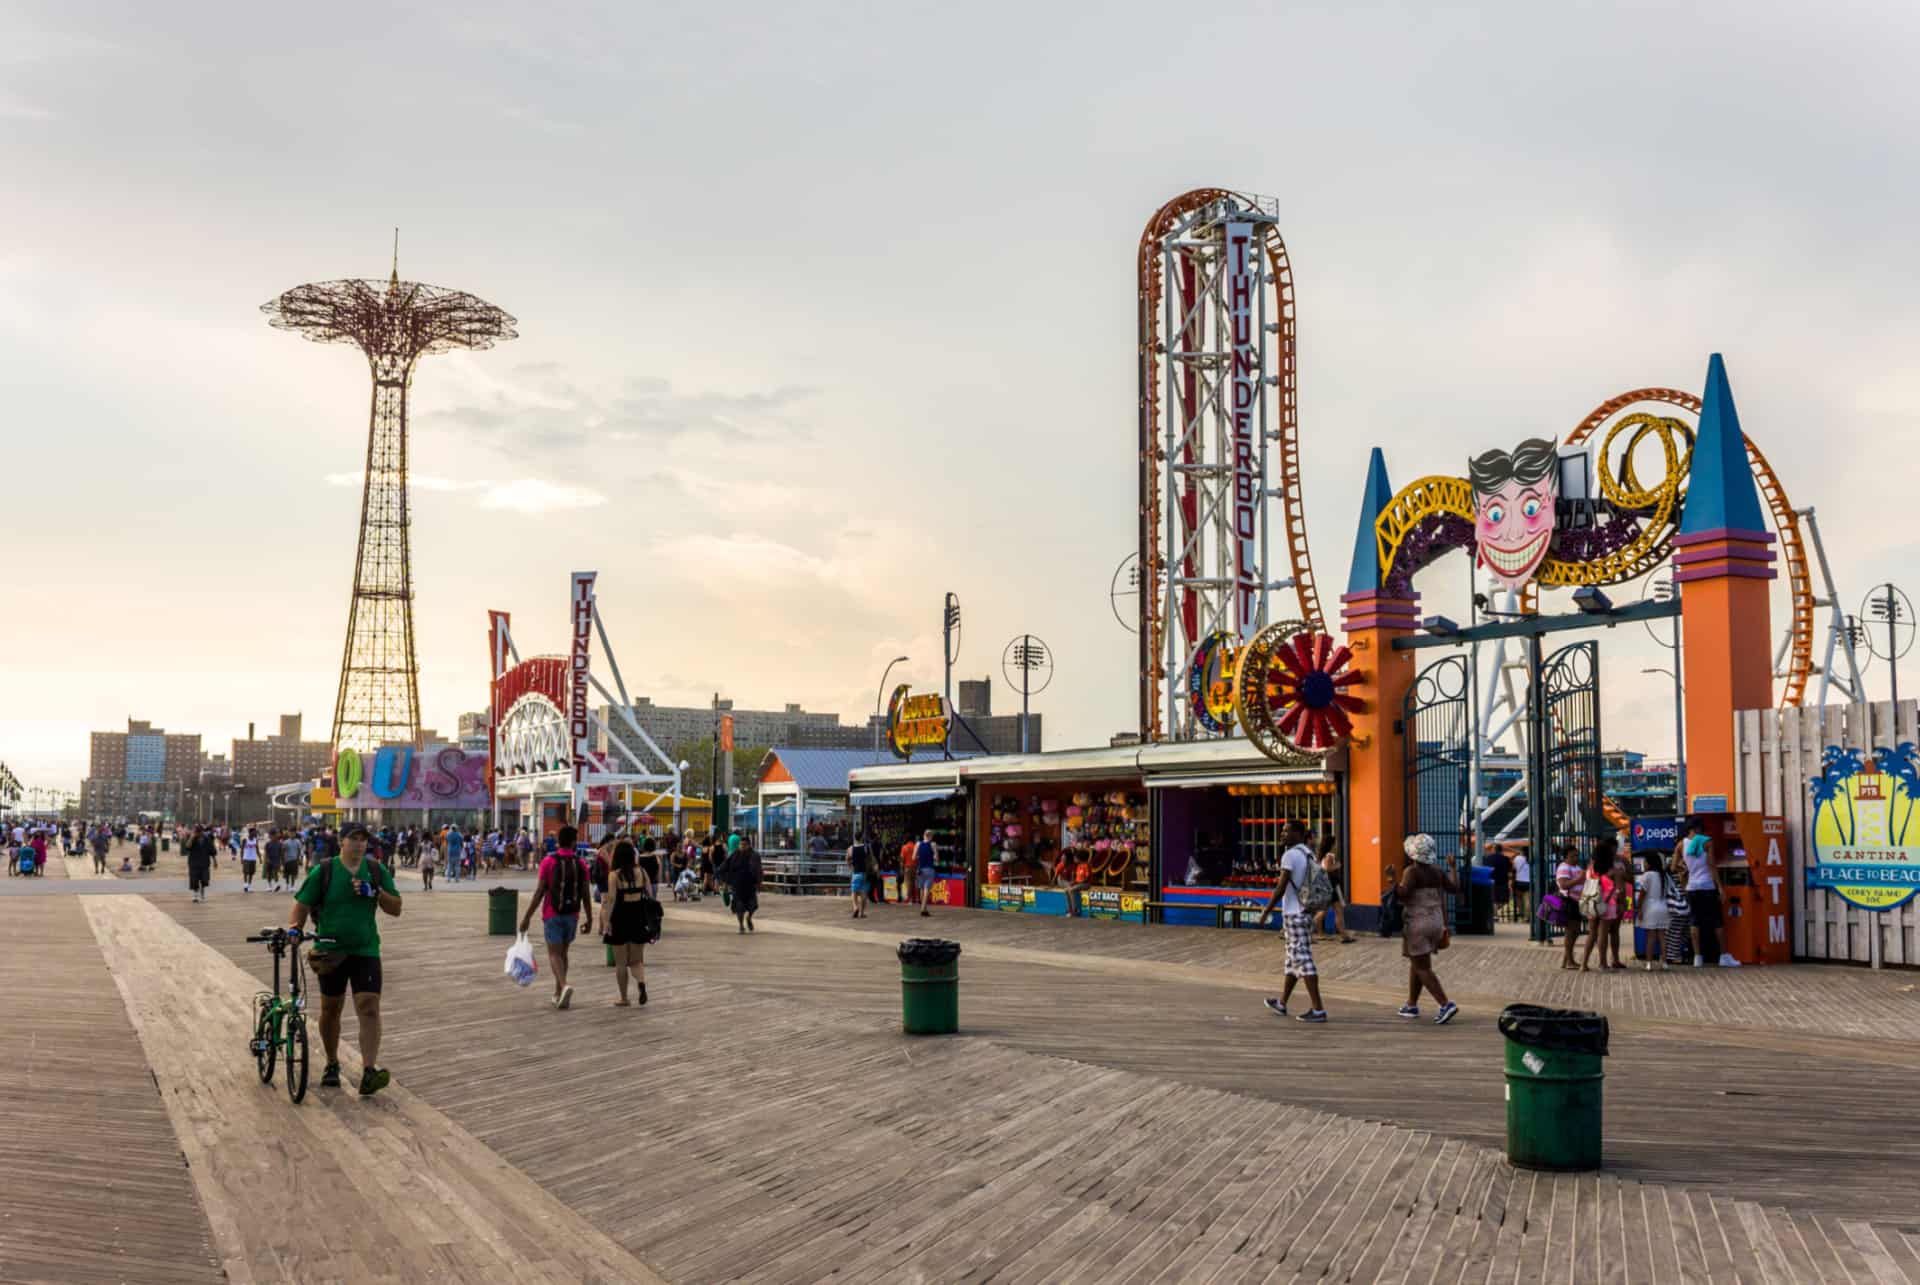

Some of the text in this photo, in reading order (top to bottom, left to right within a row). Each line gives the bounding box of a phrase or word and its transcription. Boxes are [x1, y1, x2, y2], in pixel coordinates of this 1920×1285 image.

[1232, 236, 1254, 625] THUNDERBOLT
[572, 579, 593, 783] THUNDERBOLT
[1646, 825, 1678, 840] pepsi
[1832, 851, 1908, 860] CANTINA
[1820, 868, 1865, 880] PLACE
[1880, 868, 1920, 882] BEAC
[1089, 891, 1102, 900] CAT
[1767, 838, 1785, 943] ATM
